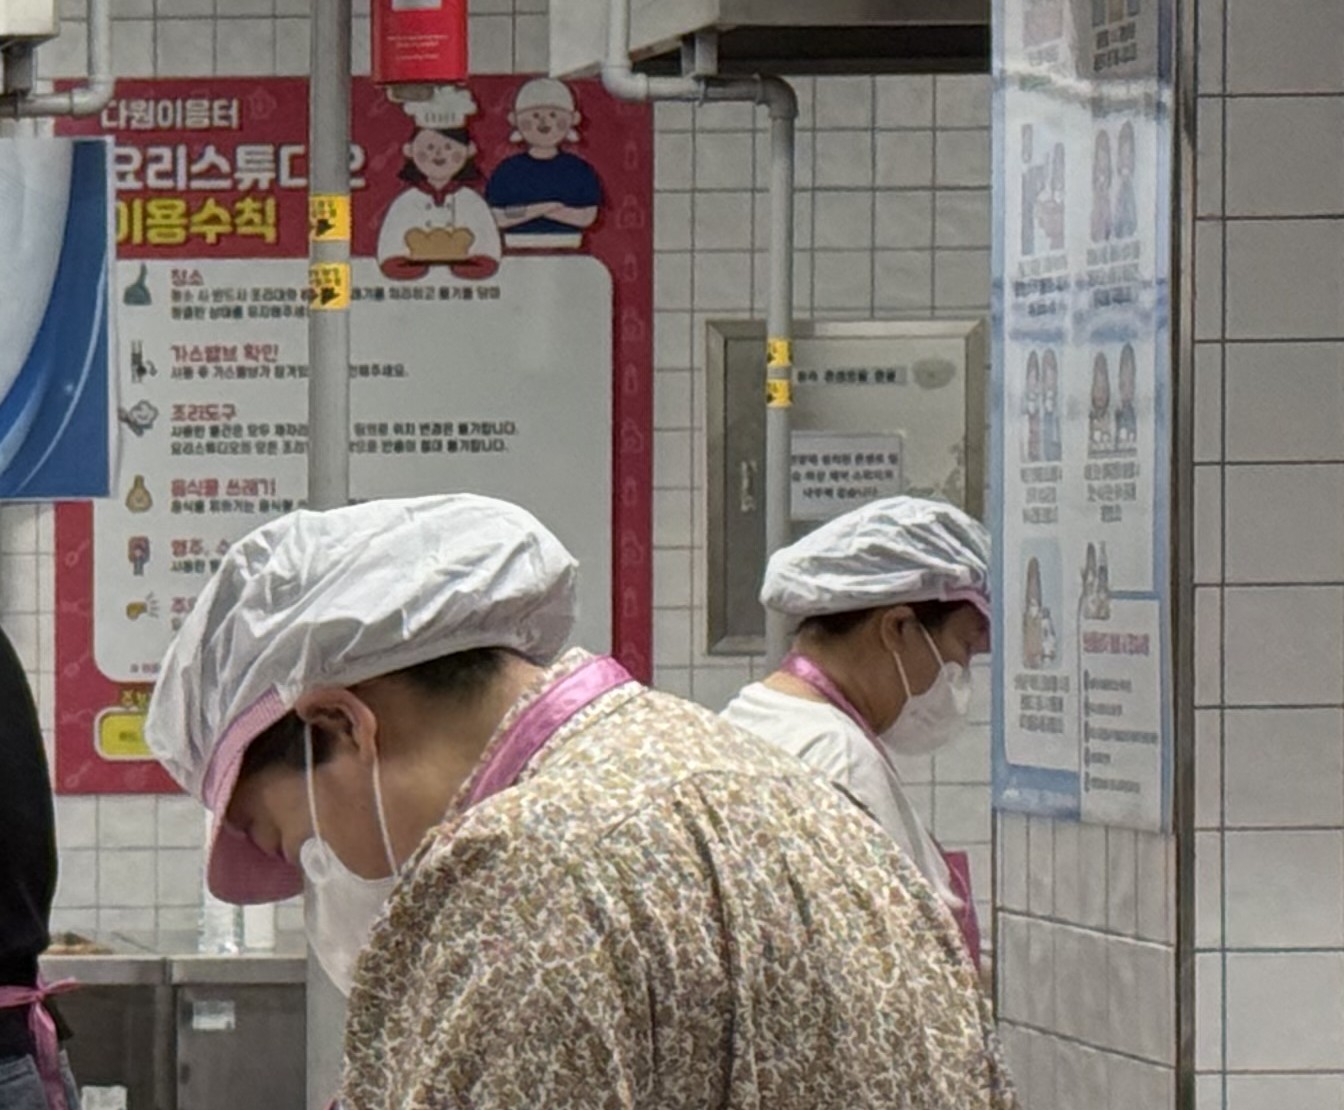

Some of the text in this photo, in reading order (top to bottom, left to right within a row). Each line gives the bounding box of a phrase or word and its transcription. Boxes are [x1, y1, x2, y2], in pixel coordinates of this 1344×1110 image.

[101, 97, 239, 130] 다원이음터
[116, 197, 276, 245] 이용수칙
[171, 343, 279, 363] 가스밸브 확인
[226, 477, 276, 497] 쓰레기
